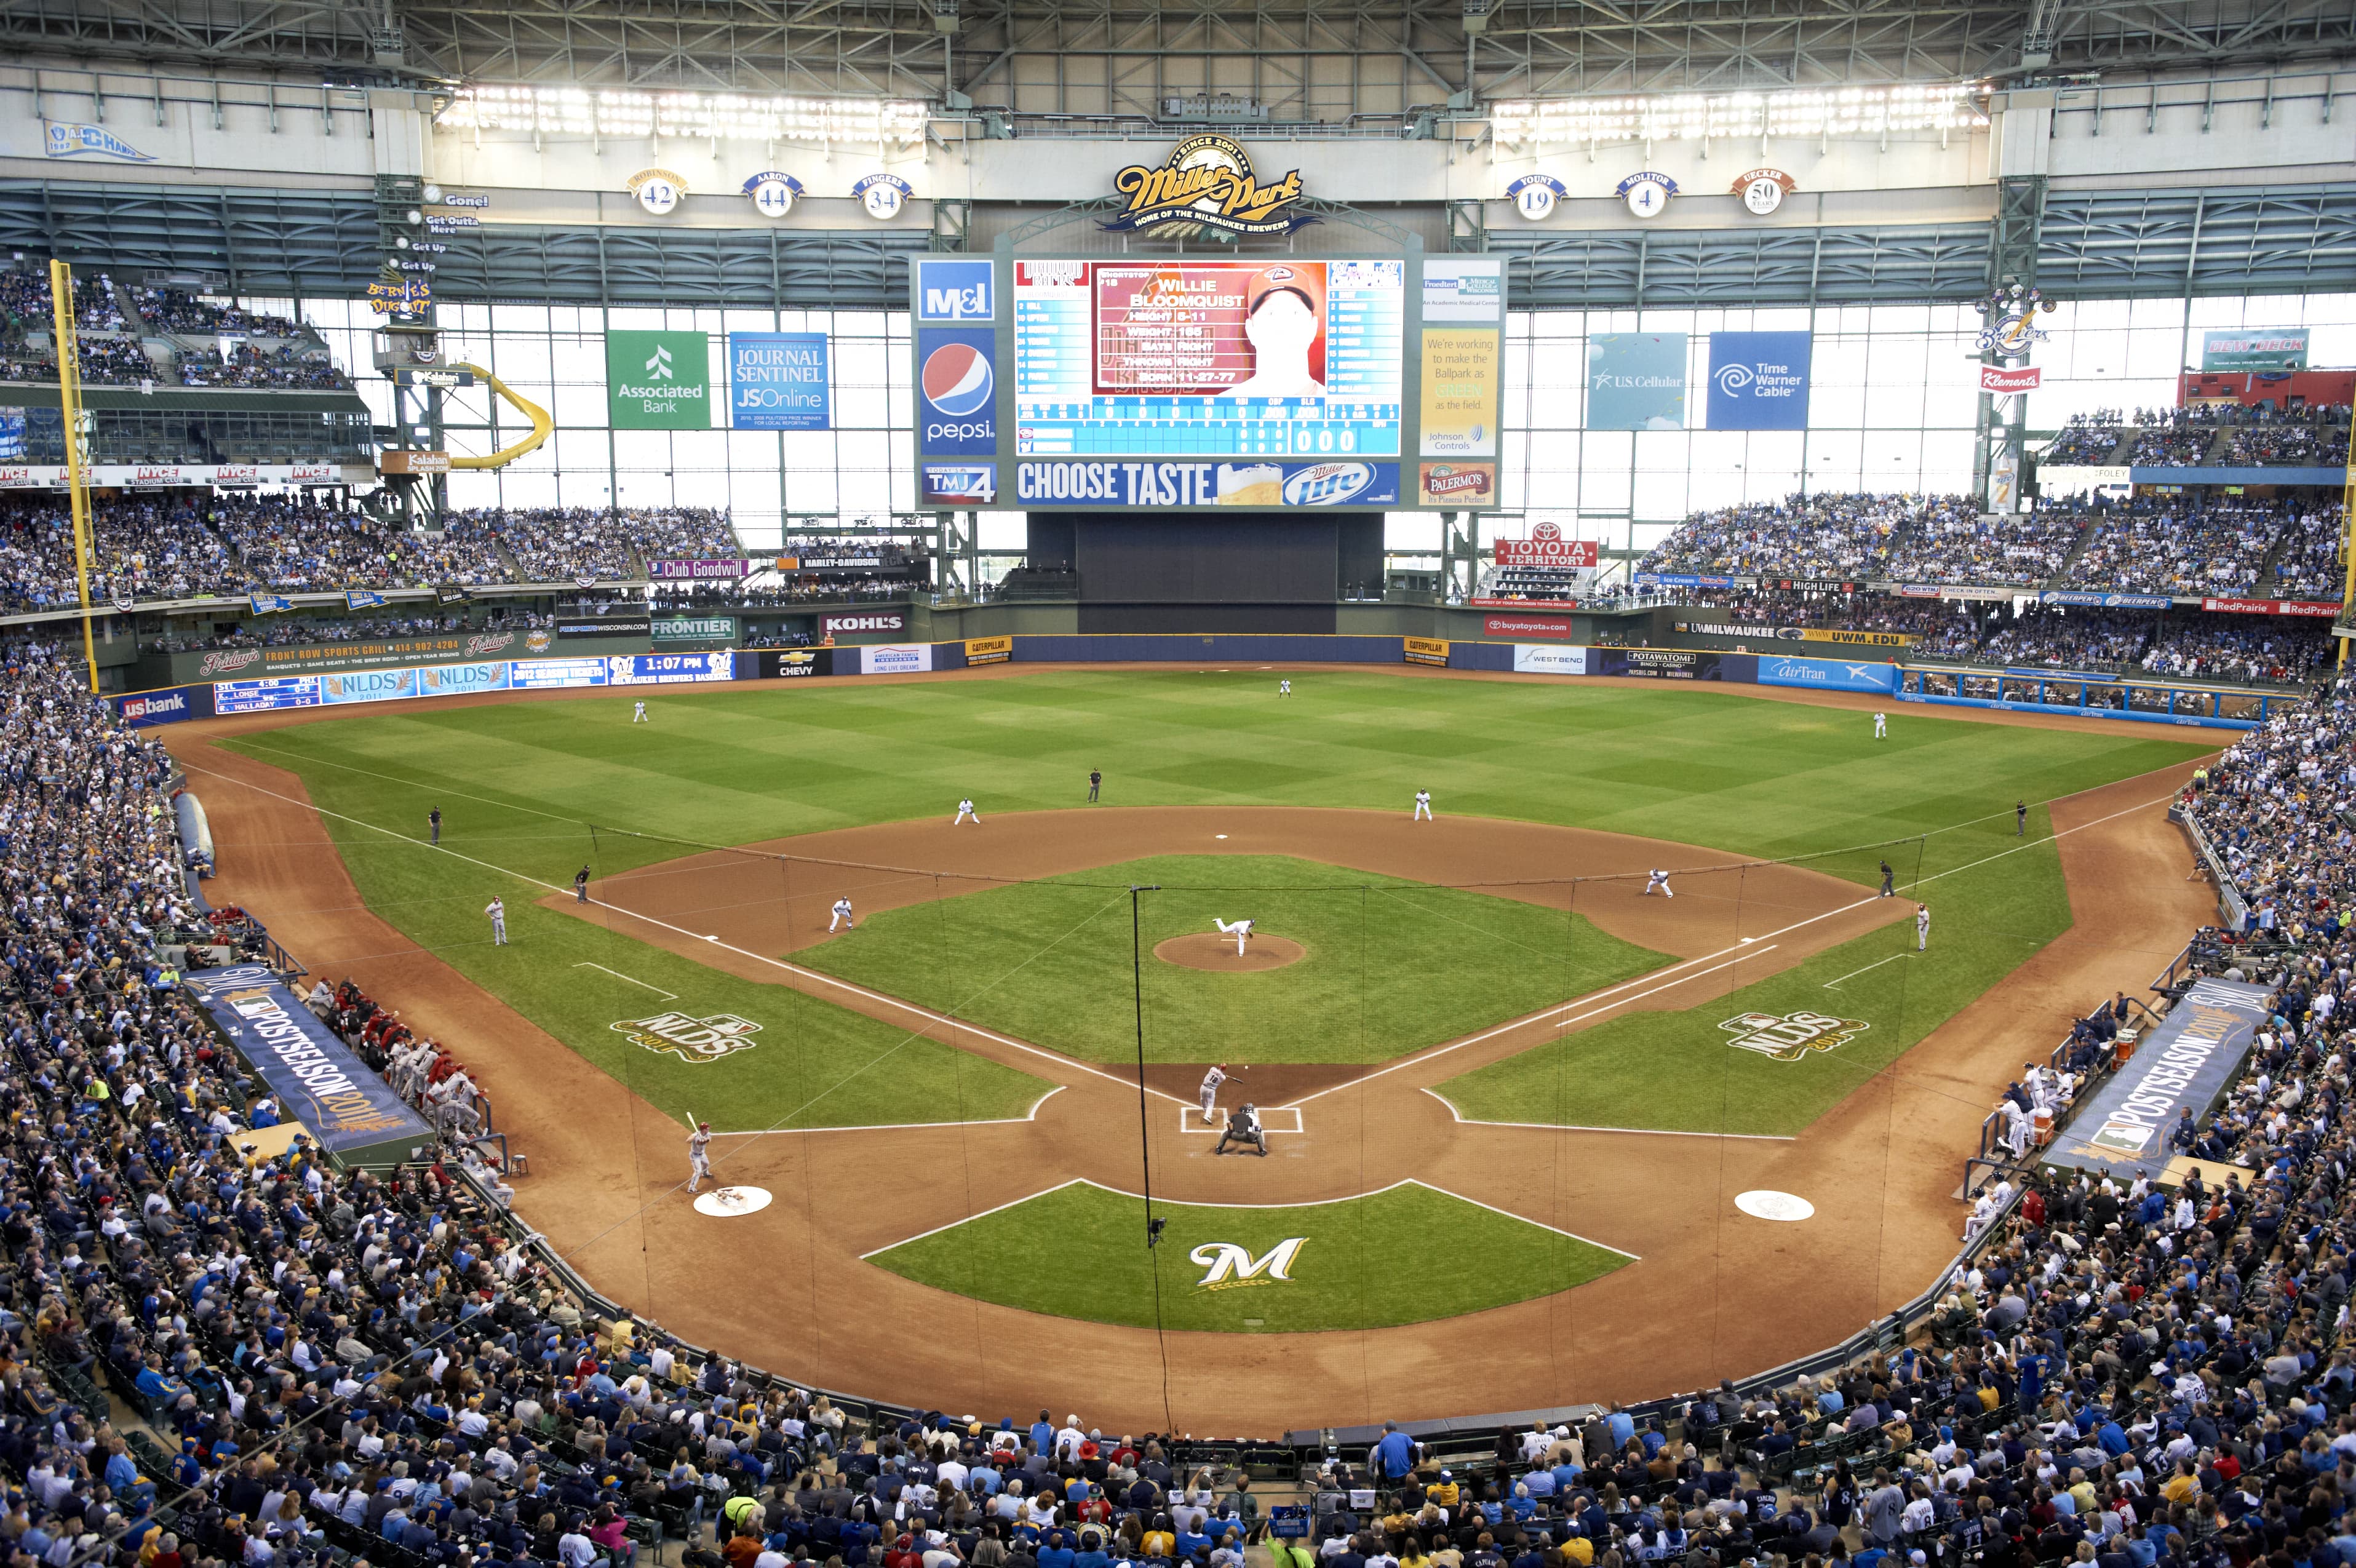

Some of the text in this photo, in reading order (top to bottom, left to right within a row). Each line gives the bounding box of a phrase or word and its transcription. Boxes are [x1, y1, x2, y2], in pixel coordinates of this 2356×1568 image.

[1180, 137, 1238, 155] SINCE 2001
[634, 169, 680, 183] ROBINSON
[757, 171, 789, 183] AARON
[861, 174, 903, 187] FINGERS
[1520, 175, 1554, 186] YOUNT
[1625, 172, 1670, 186] MOLITOR
[1743, 170, 1782, 182] UECKER
[644, 186, 672, 204] 42
[760, 188, 787, 207] 44
[1116, 165, 1300, 217] Miller Park
[1752, 184, 1774, 200] 50
[445, 195, 488, 207] Gone!
[870, 191, 896, 210] 34
[1524, 192, 1548, 211] 19
[1638, 189, 1651, 209] 4
[426, 216, 479, 226] Get Outta
[1135, 212, 1160, 227] HOME
[1175, 210, 1192, 218] THE
[1195, 212, 1245, 231] MILWAUKEE
[1247, 220, 1290, 233] BREWERS
[432, 244, 447, 253] Up
[421, 262, 436, 271] Up
[1158, 279, 1217, 292] WILLIE
[1424, 280, 1458, 289] Froedtert
[370, 298, 431, 314] DUGOUT
[1130, 294, 1245, 308] BLOOMQUIST
[1129, 312, 1206, 321] HEIGHT 5-11
[1127, 327, 1172, 336] WEIGHT
[1428, 339, 1493, 352] We're working
[2207, 338, 2306, 353] DEW DECK
[736, 349, 823, 367] JOURNAL
[1123, 357, 1172, 366] THROWS
[1433, 354, 1487, 364] to make the
[736, 367, 823, 383] SENTINEL
[1435, 368, 1472, 381] Ballpark
[1756, 363, 1788, 374] Time
[424, 370, 460, 383] Kalahari
[1139, 372, 1172, 381] BORN
[1615, 375, 1683, 388] U.S. Cellular
[1756, 374, 1802, 386] Warner
[1983, 372, 2038, 387] Klement's
[618, 383, 702, 399] Associated
[737, 388, 822, 407] JSOnline
[1436, 384, 1483, 398] GREEN
[1755, 386, 1791, 397] Cable
[643, 399, 677, 413] Bank
[1447, 401, 1461, 410] the
[928, 421, 991, 442] pepsi
[1428, 432, 1463, 441] Johnson
[408, 454, 447, 465] Kalahari
[138, 467, 179, 478] NYCE
[218, 467, 257, 477] NYCE
[292, 467, 330, 477] NYCE
[1311, 464, 1347, 480] Miller
[2099, 469, 2127, 478] FOLEY
[1018, 463, 1217, 505] CHOOSE TASTE.
[1297, 471, 1361, 504] Lite
[1431, 473, 1482, 492] PALERMO'S
[1507, 541, 1586, 555] TOYOTA
[805, 558, 880, 568] HARLEY-DAVIDSON
[1507, 555, 1586, 565] TERRITORY
[665, 560, 742, 577] Club Goodwill
[1793, 581, 1839, 592] HIGH LIFE
[2060, 594, 2158, 607] BEERPEN BEERPEN
[2217, 603, 2267, 612] RedPrairie
[651, 619, 732, 635] FRONTIER
[826, 616, 902, 631] KOHL'S
[265, 639, 459, 661] FRONT ROW SPORTS GRILL 414-902-4204
[465, 632, 515, 657] Friday's
[972, 640, 1005, 651] CATERPILLAR
[1409, 640, 1442, 653] CATERPILLAR
[200, 648, 260, 675] Friday's
[646, 657, 702, 670] 1:07 PM
[1632, 653, 1692, 664] POTAWATOMI
[437, 666, 490, 685] NLDS
[780, 666, 813, 677] CHEVY
[343, 672, 397, 693] NLDS
[234, 702, 275, 711] HALLADAY
[634, 1014, 747, 1054] NLDS
[1735, 1014, 1842, 1054] NLDS
[635, 1035, 677, 1052] 2011
[1807, 1033, 1847, 1050] 2011
[247, 1009, 357, 1097] POSTSEASON
[2109, 1033, 2219, 1128] POSTSEASON
[1841, 1491, 1851, 1505] 8
[1888, 1502, 1896, 1516] 8
